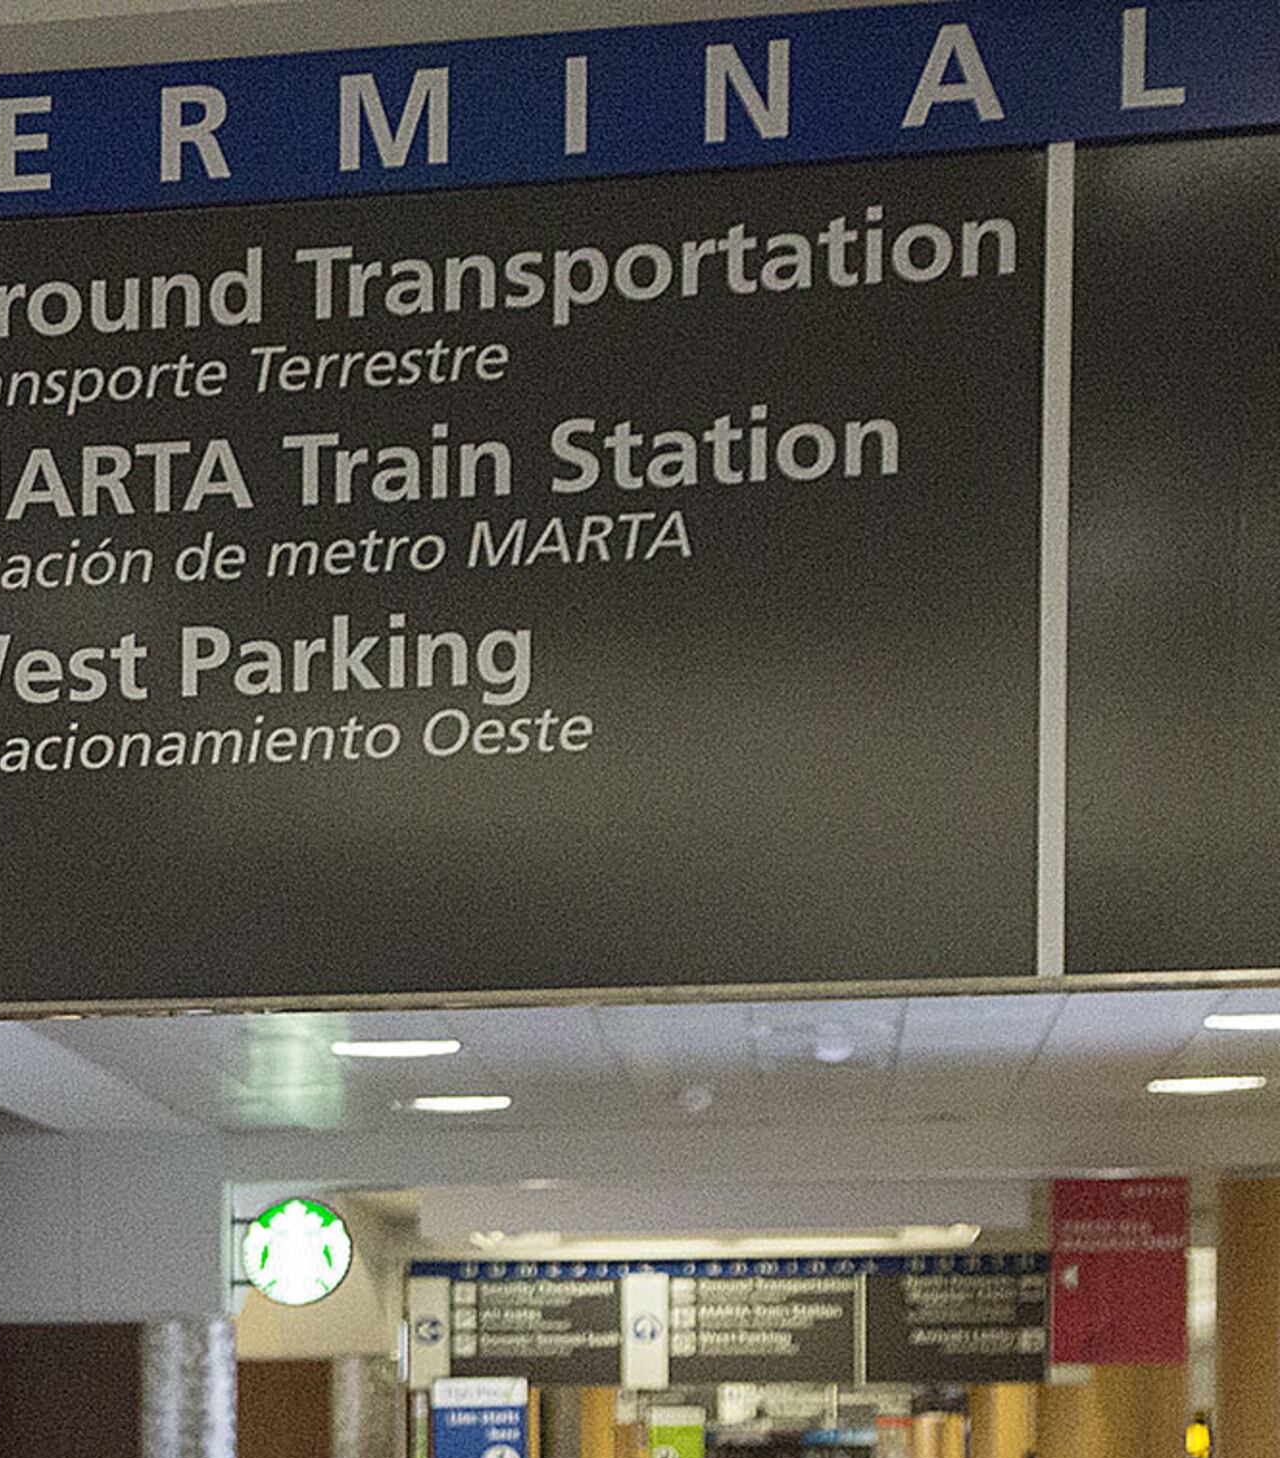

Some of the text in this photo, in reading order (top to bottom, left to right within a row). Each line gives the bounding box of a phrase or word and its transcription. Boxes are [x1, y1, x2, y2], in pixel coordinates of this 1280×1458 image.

[296, 205, 1019, 326] Transportation
[251, 338, 510, 394] Terrestre
[282, 423, 513, 506] Train
[550, 403, 900, 495] Station
[175, 531, 246, 582] de
[266, 527, 446, 579] metro
[467, 510, 694, 570] MARTA
[180, 613, 534, 706] Parking
[421, 706, 594, 758] Oeste
